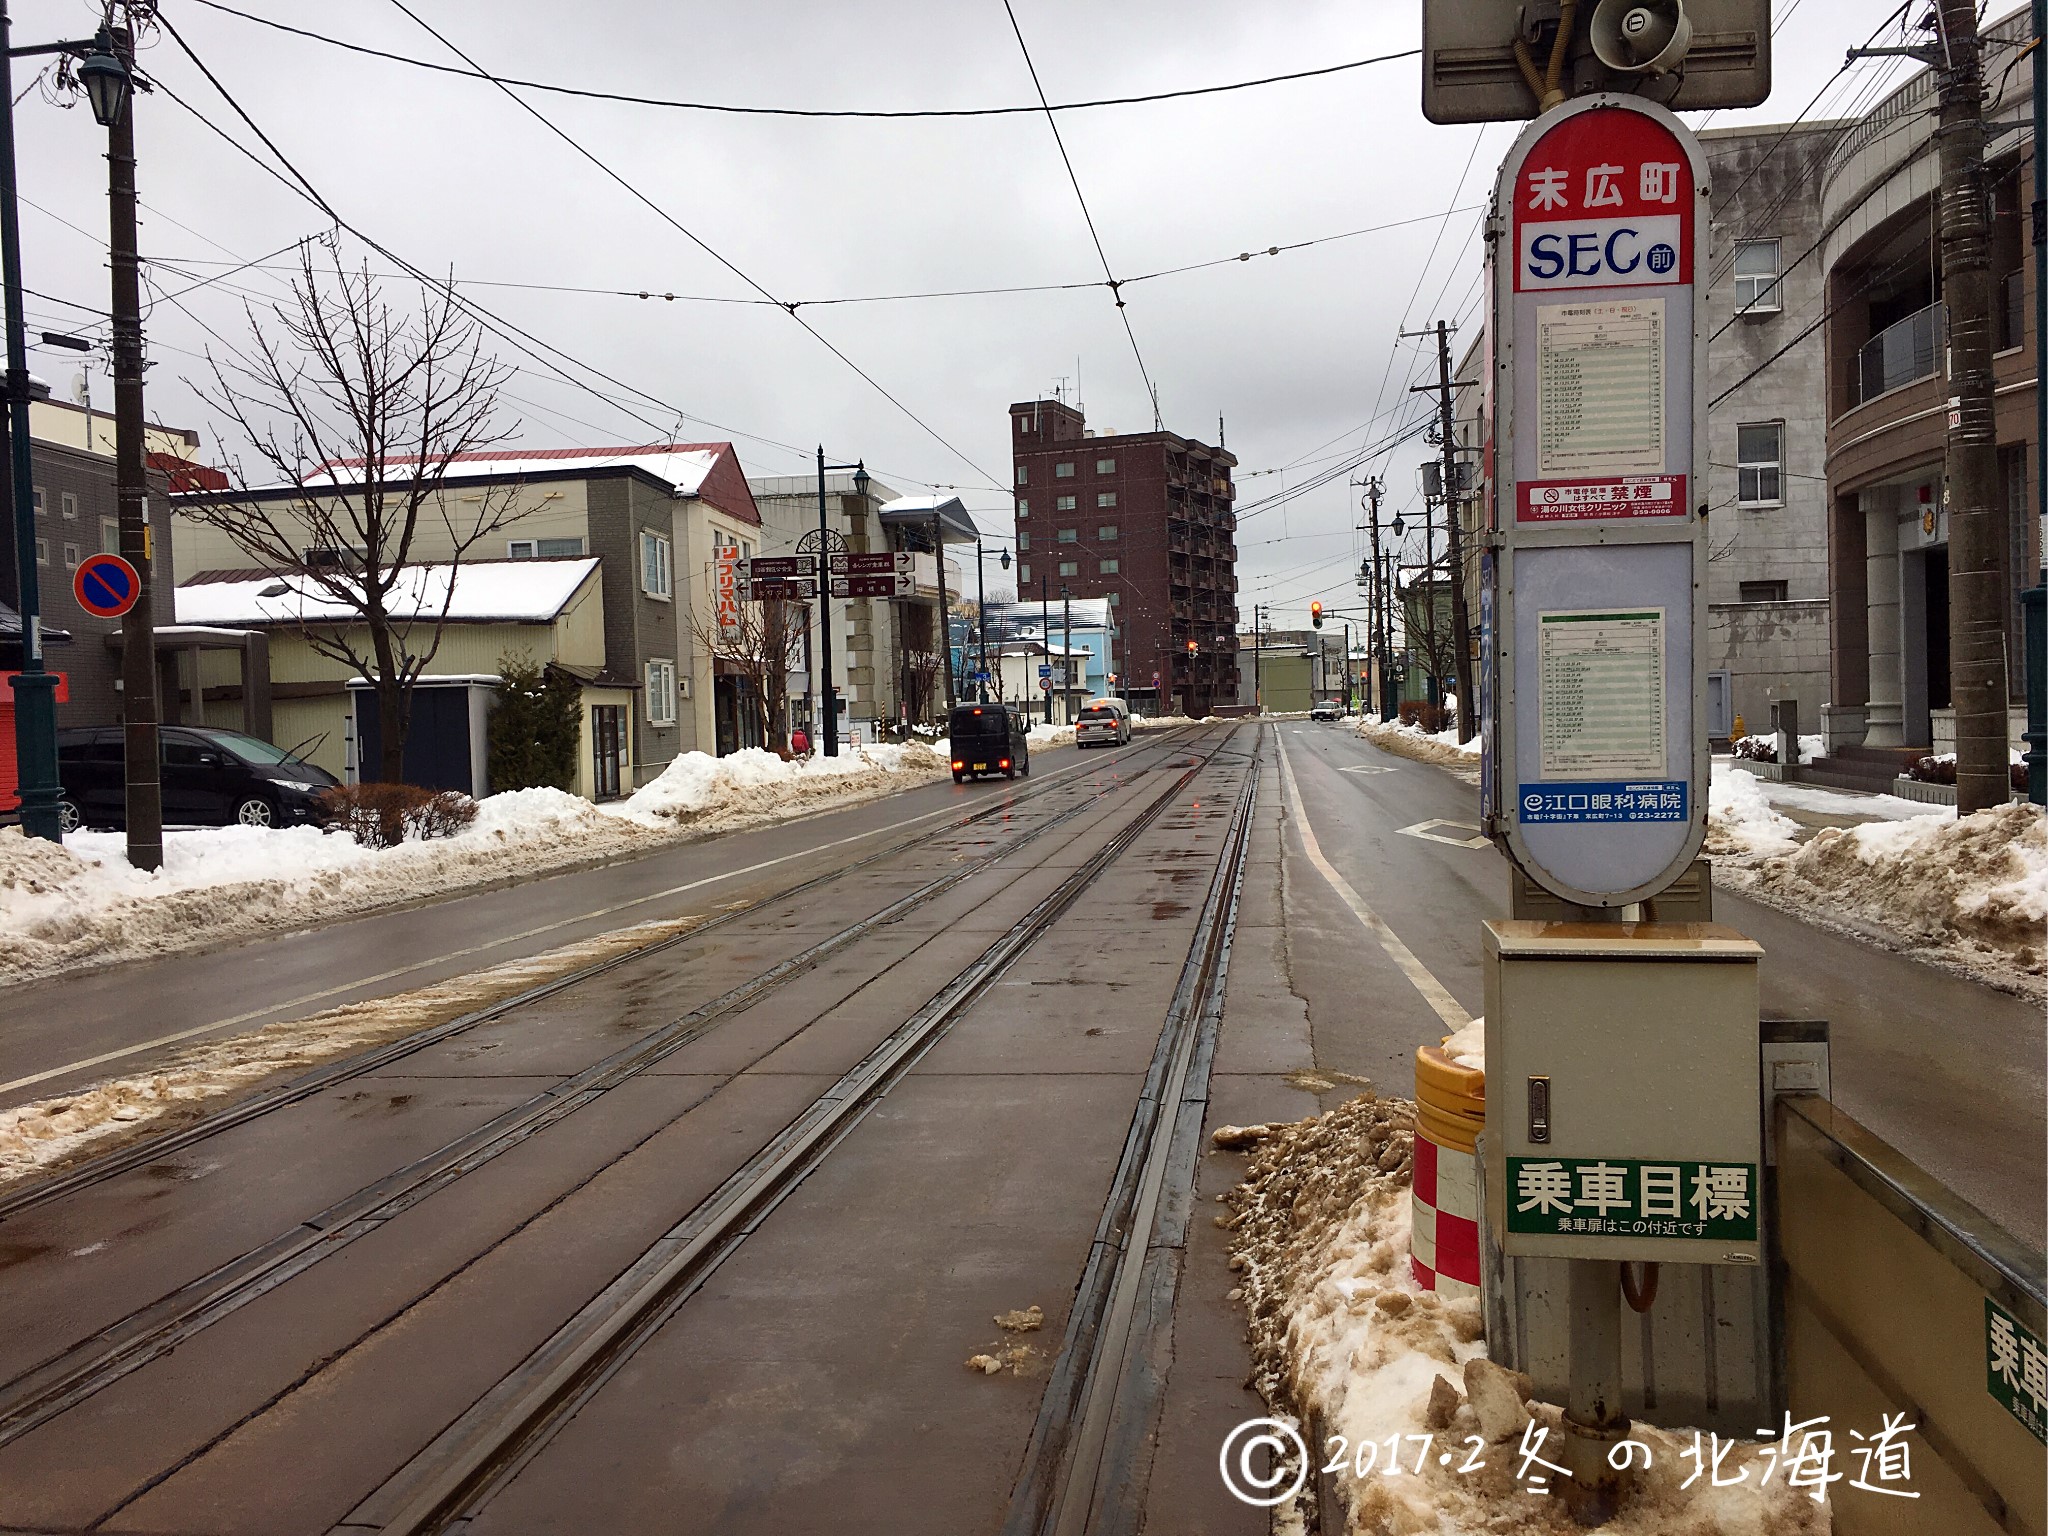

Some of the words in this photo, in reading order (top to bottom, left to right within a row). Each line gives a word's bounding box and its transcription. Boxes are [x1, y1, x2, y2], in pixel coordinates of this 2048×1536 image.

[1528, 161, 1681, 211] 末広町
[1528, 228, 1641, 279] SEC
[1611, 485, 1653, 500] 禁煙
[1540, 503, 1627, 514] 湯の川女性クリニック
[1545, 793, 1681, 810] 江口眼科病院
[1516, 1162, 1750, 1221] 乗車目標
[1558, 1218, 1708, 1236] 乗車扉はこの付近です
